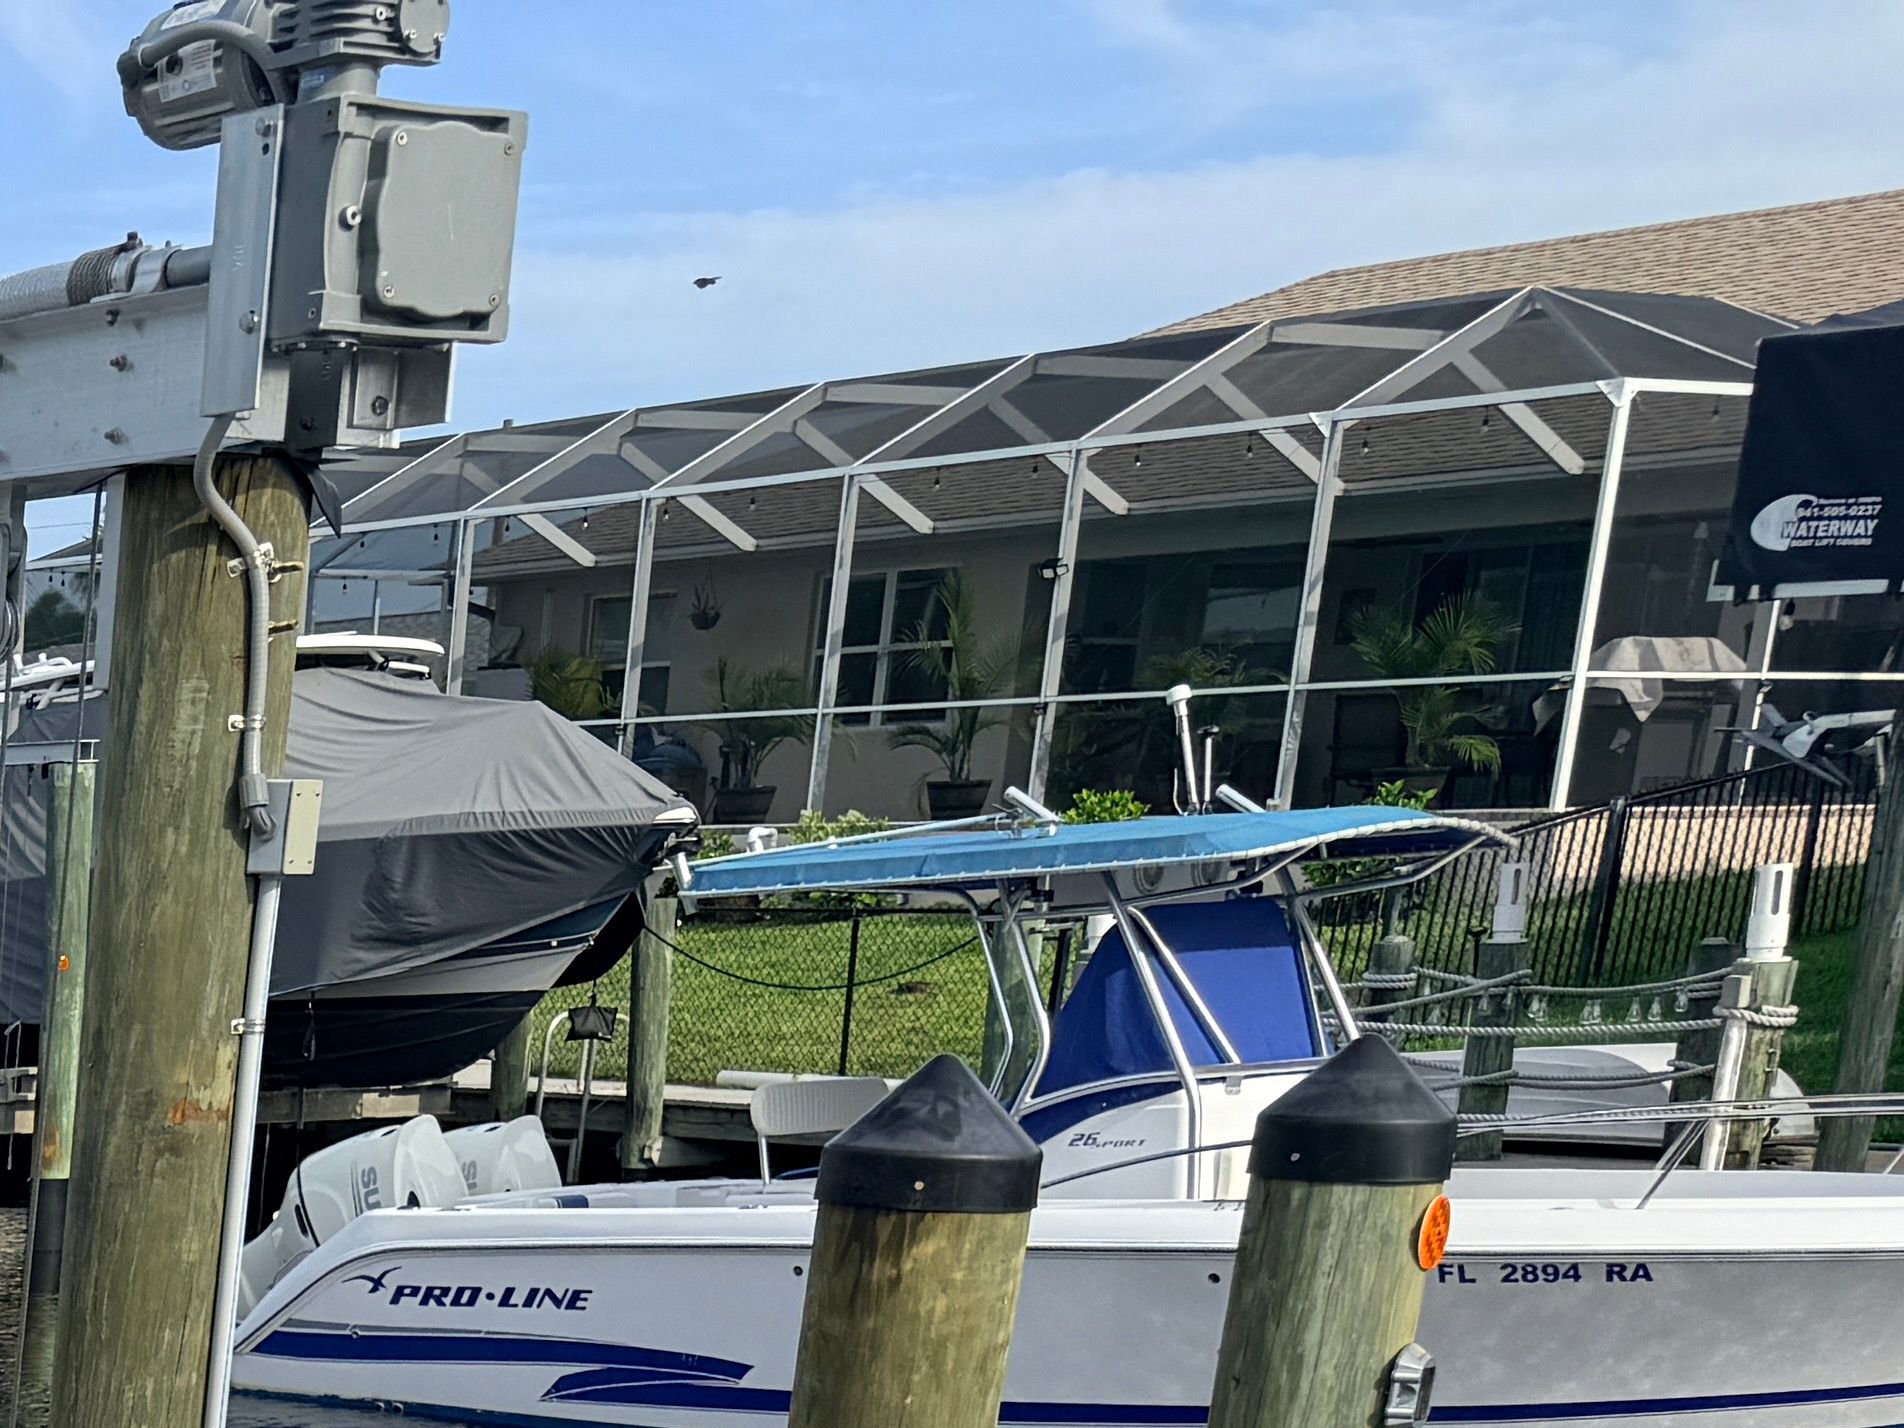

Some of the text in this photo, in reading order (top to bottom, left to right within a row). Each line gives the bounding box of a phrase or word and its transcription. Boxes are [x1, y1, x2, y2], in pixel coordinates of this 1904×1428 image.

[1782, 519, 1880, 539] WATERWAY
[1437, 1262, 1654, 1284] FL 2894 RA
